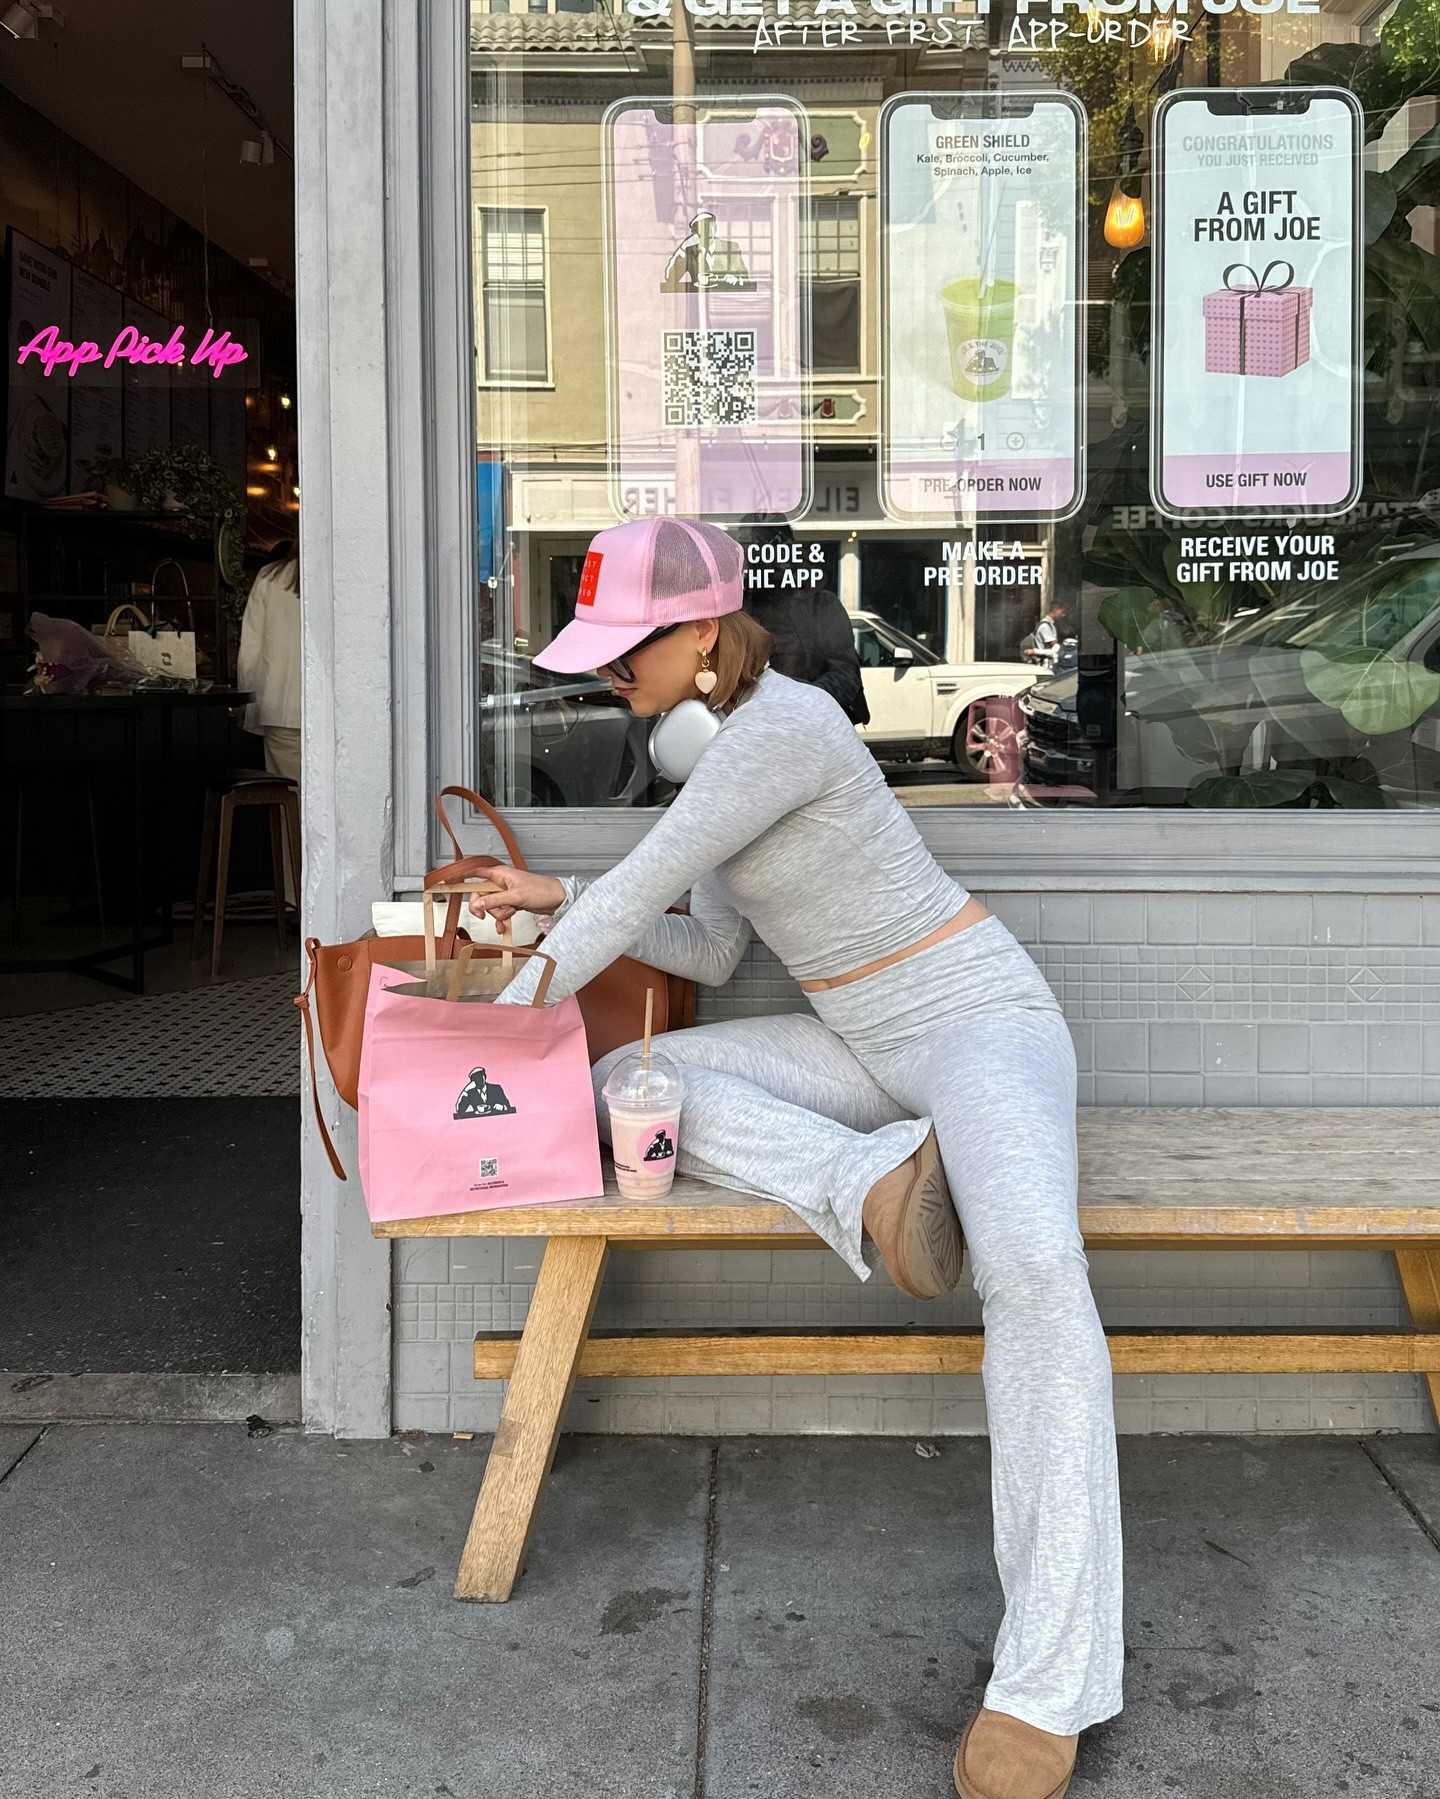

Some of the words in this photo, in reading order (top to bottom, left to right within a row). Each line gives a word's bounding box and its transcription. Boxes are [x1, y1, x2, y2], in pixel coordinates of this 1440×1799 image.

[753, 17, 862, 54] AFTER
[885, 18, 984, 46] FRST
[1008, 16, 1193, 52] APP-ORDER
[936, 135, 979, 149] GREEN
[983, 134, 1030, 148] SHIELD
[1182, 134, 1334, 151] CONGRATULATIONS
[917, 154, 943, 164] Kale,
[945, 153, 991, 164] Broccoli,
[994, 152, 1050, 163] Cucumber,
[1197, 154, 1222, 167] YOU
[1225, 154, 1256, 167] JUST
[1259, 153, 1319, 166] RECEIVED
[934, 166, 978, 177] Spinach,
[981, 166, 1014, 176] Apple,
[1017, 166, 1032, 175] Ice
[1217, 191, 1235, 215] A
[1243, 190, 1297, 215] GIFT
[1194, 218, 1265, 242] FROM
[1274, 217, 1321, 241] JOE
[17, 325, 103, 377] App
[103, 325, 186, 369] Pick
[190, 328, 249, 378] Up
[977, 433, 985, 451] 1
[924, 477, 1004, 493] PRE-ORDER
[1008, 477, 1042, 491] NOW
[1206, 473, 1233, 488] USE
[1237, 473, 1270, 488] GIFT
[1273, 472, 1307, 487] NOW
[747, 543, 803, 564] CODE
[808, 543, 826, 563] &
[942, 541, 1004, 562] MAKE
[1009, 541, 1025, 561] A
[1180, 536, 1269, 557] RECEIVE
[1275, 535, 1335, 556] YOUR
[780, 568, 824, 589] APP
[924, 567, 963, 587] PRE
[973, 566, 1044, 586] ORDER
[1176, 561, 1222, 583] GIFT
[1228, 561, 1291, 582] FROM
[1296, 560, 1339, 581] JOE
